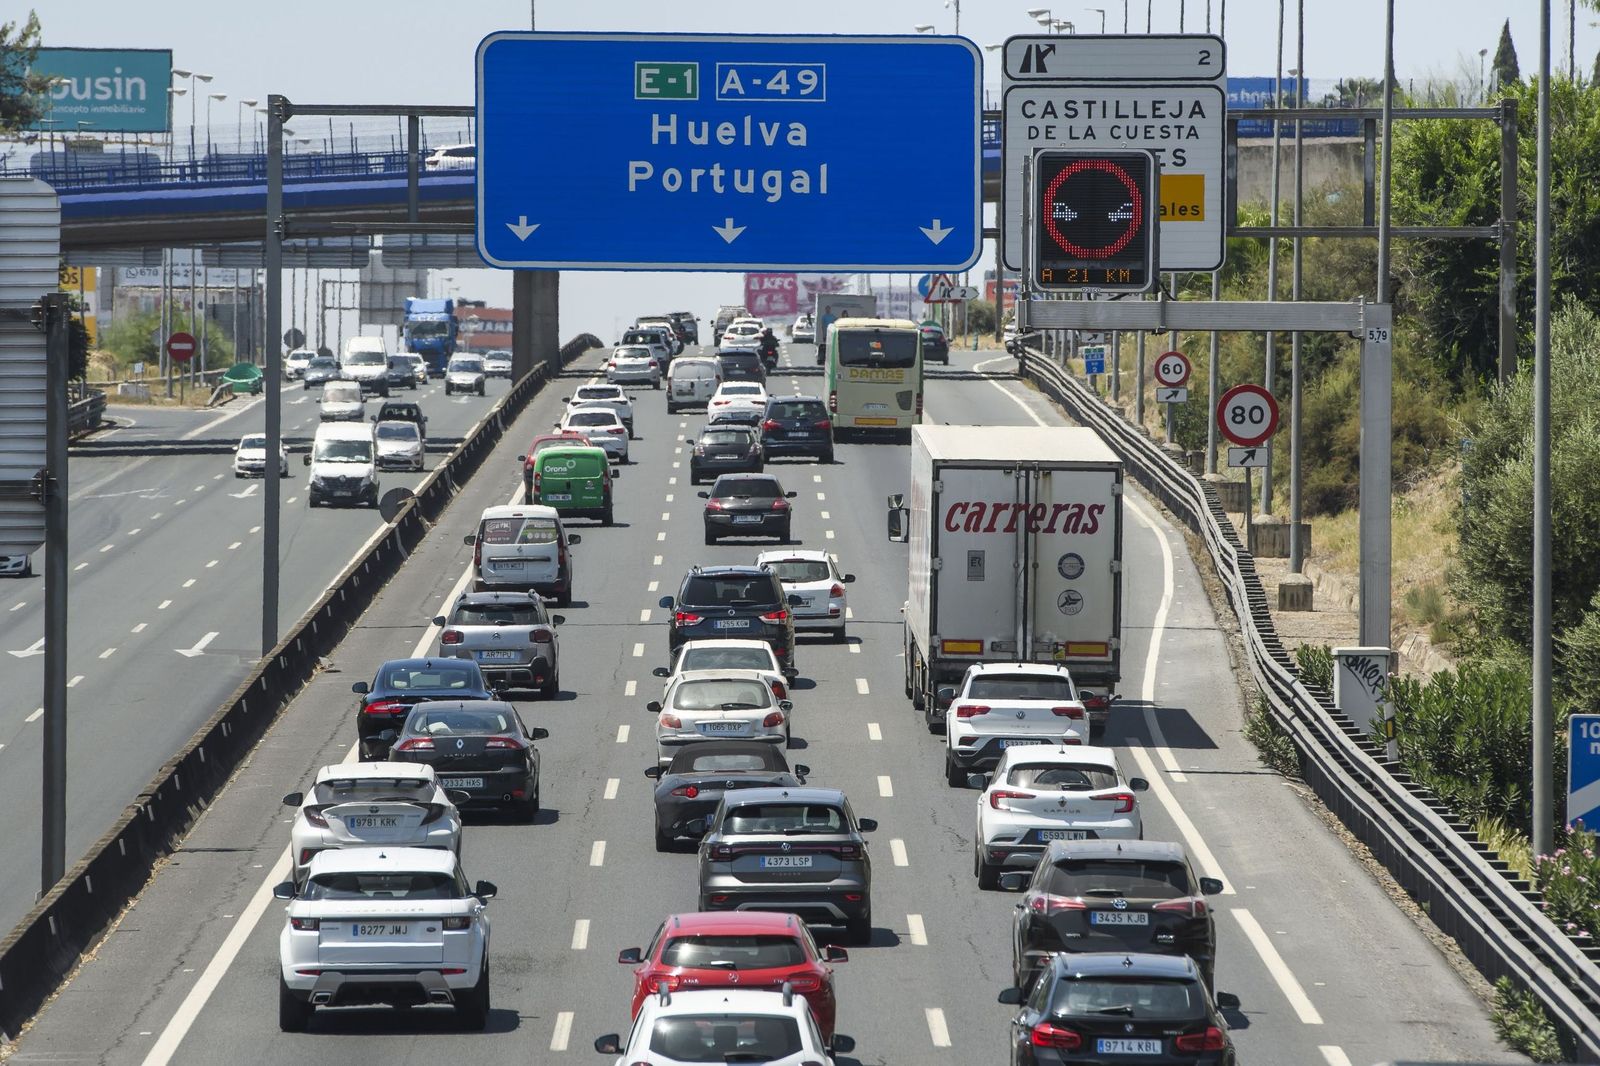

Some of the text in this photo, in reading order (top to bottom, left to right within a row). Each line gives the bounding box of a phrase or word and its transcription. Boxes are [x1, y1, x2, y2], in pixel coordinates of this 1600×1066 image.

[1198, 50, 1211, 66] 2
[720, 69, 820, 96] A-49
[1021, 99, 1206, 120] CASTILLEJA
[652, 113, 808, 147] Huelva
[1028, 125, 1200, 140] DE LA CUESTA
[628, 160, 828, 203] Portugal
[1041, 268, 1130, 283] A 21 KM
[762, 277, 794, 291] KFC
[960, 289, 967, 298] 2
[849, 368, 905, 380] DAMAS
[1161, 363, 1182, 376] 60
[1231, 405, 1264, 425] 80
[944, 501, 1106, 535] carreras
[355, 817, 397, 828] 9781 KRK
[1043, 831, 1084, 841] 6593 LWN
[767, 857, 810, 866] 4373 LSP
[1097, 912, 1146, 923] 3435 KJB
[360, 925, 408, 936] 8277 JMJ
[1104, 1040, 1160, 1052] 9714 KBL
